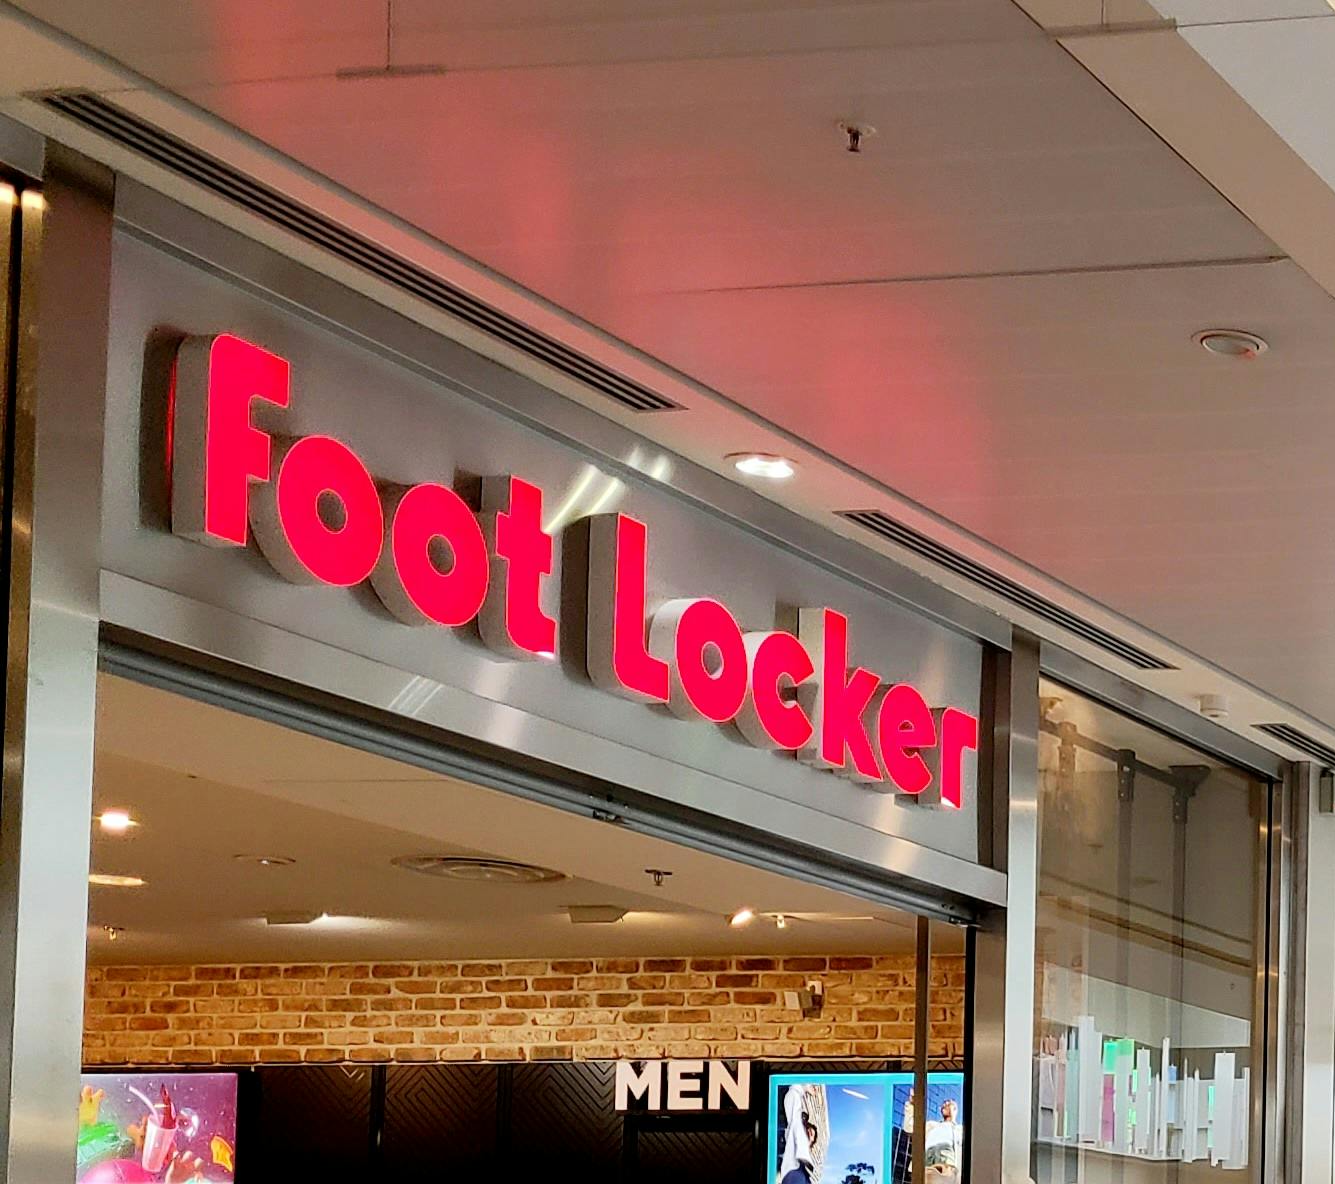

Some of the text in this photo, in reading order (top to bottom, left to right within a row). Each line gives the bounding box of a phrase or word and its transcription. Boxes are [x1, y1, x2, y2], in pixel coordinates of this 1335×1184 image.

[204, 331, 979, 810] Foot Locker
[614, 1059, 751, 1111] MEN
